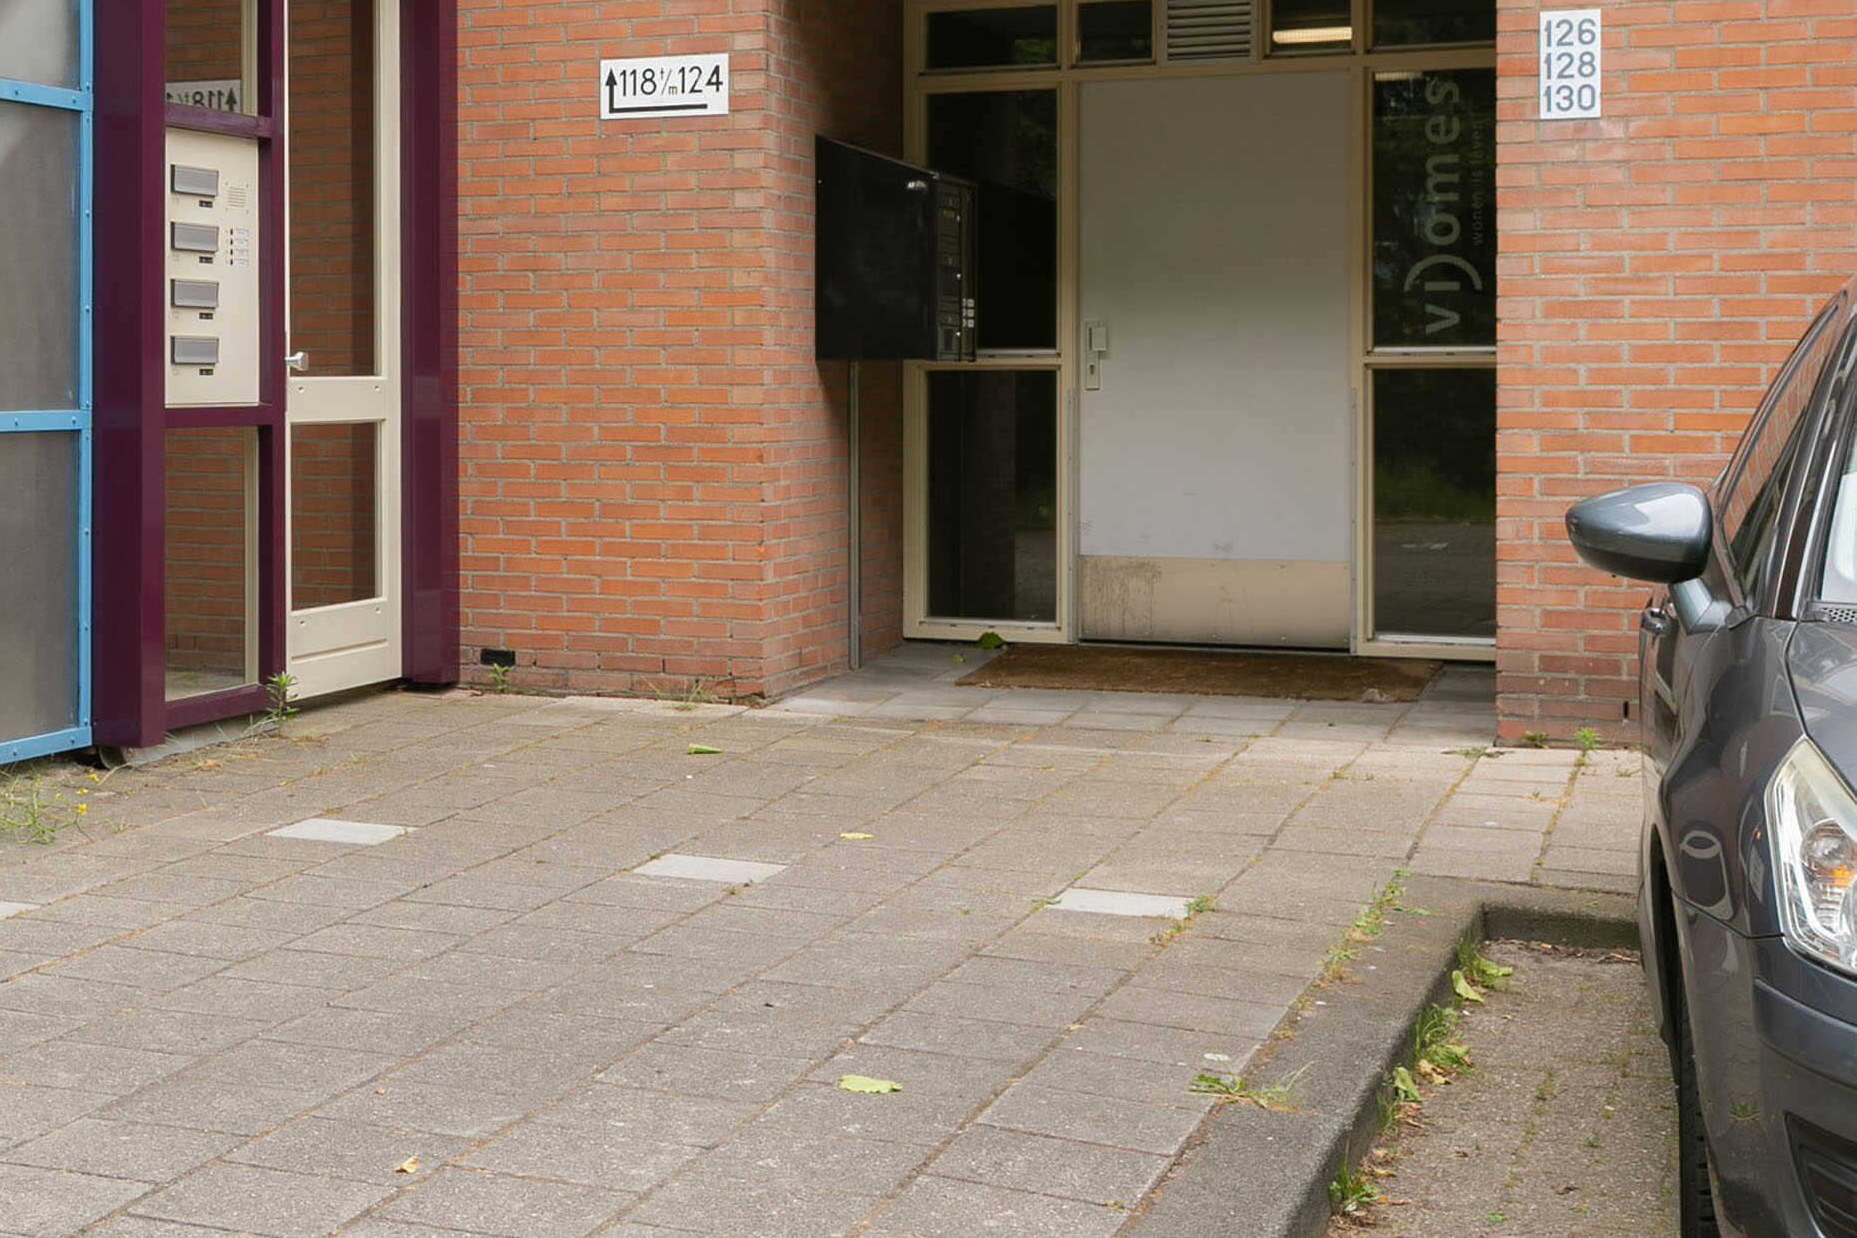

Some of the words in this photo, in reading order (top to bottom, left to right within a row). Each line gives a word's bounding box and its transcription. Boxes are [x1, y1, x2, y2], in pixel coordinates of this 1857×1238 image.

[1544, 18, 1596, 48] 126
[1544, 51, 1596, 80] 128
[1544, 83, 1596, 113] 130
